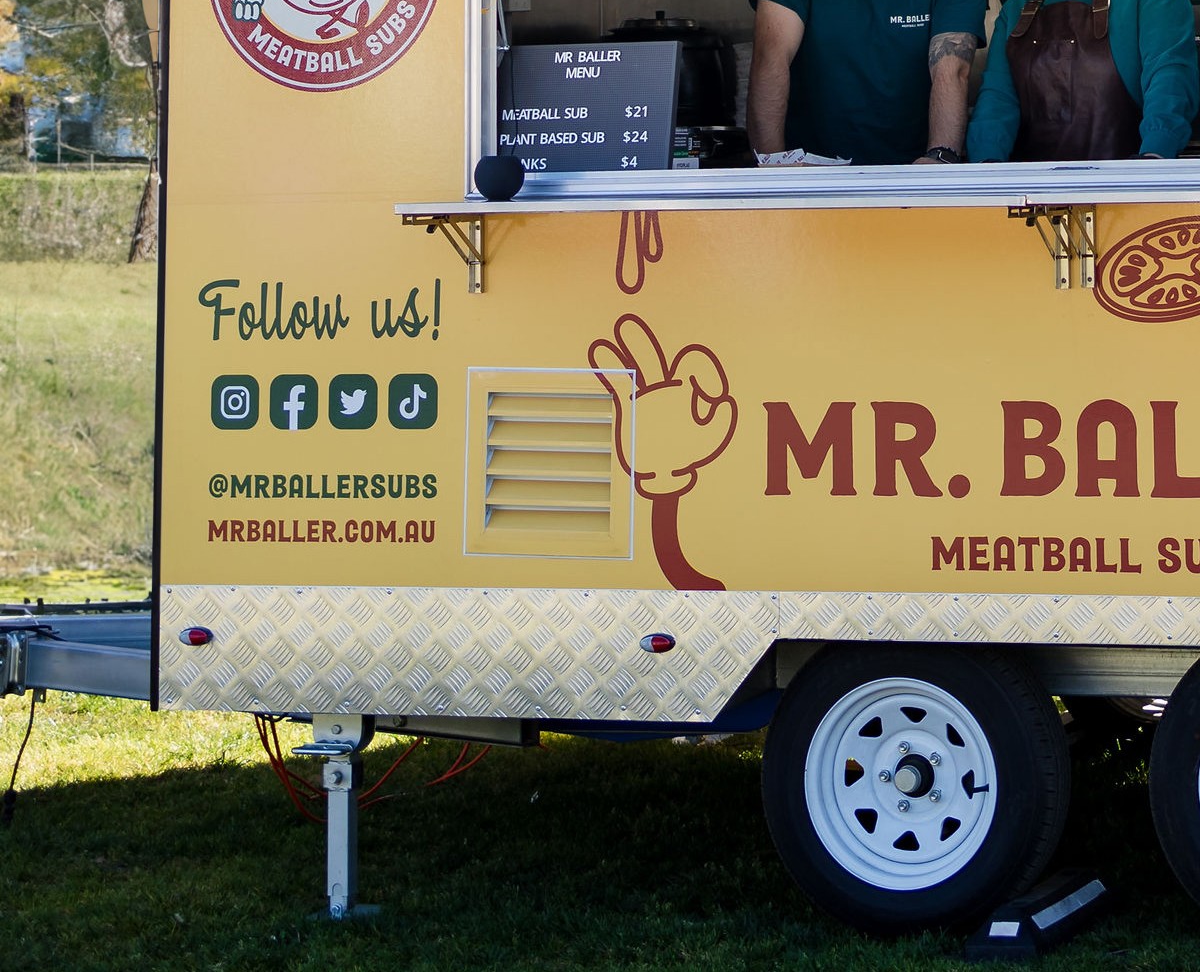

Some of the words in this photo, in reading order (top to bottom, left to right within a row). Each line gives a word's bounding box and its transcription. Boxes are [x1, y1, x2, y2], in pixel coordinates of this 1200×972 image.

[889, 15, 905, 24] MR.
[906, 13, 931, 24] BALLE
[247, 23, 363, 73] MEATBALL
[365, 0, 416, 55] SUBS
[554, 50, 573, 64] MR
[577, 50, 622, 63] BALLER
[565, 66, 601, 79] MENU
[502, 108, 561, 121] MEATBALL
[564, 107, 588, 120] SUB
[624, 105, 649, 119] $21
[500, 133, 538, 146] PLANT
[540, 132, 578, 145] BASED
[580, 131, 605, 144] SUB
[622, 130, 649, 143] $24
[621, 156, 638, 169] $4
[198, 278, 350, 341] Follow
[370, 278, 441, 341] us!
[762, 399, 972, 500] MR.
[208, 473, 438, 500] @MRBALLERSUBS
[207, 519, 436, 544] MRBALLER.COM.AU
[930, 536, 1143, 574] MEATBALL
